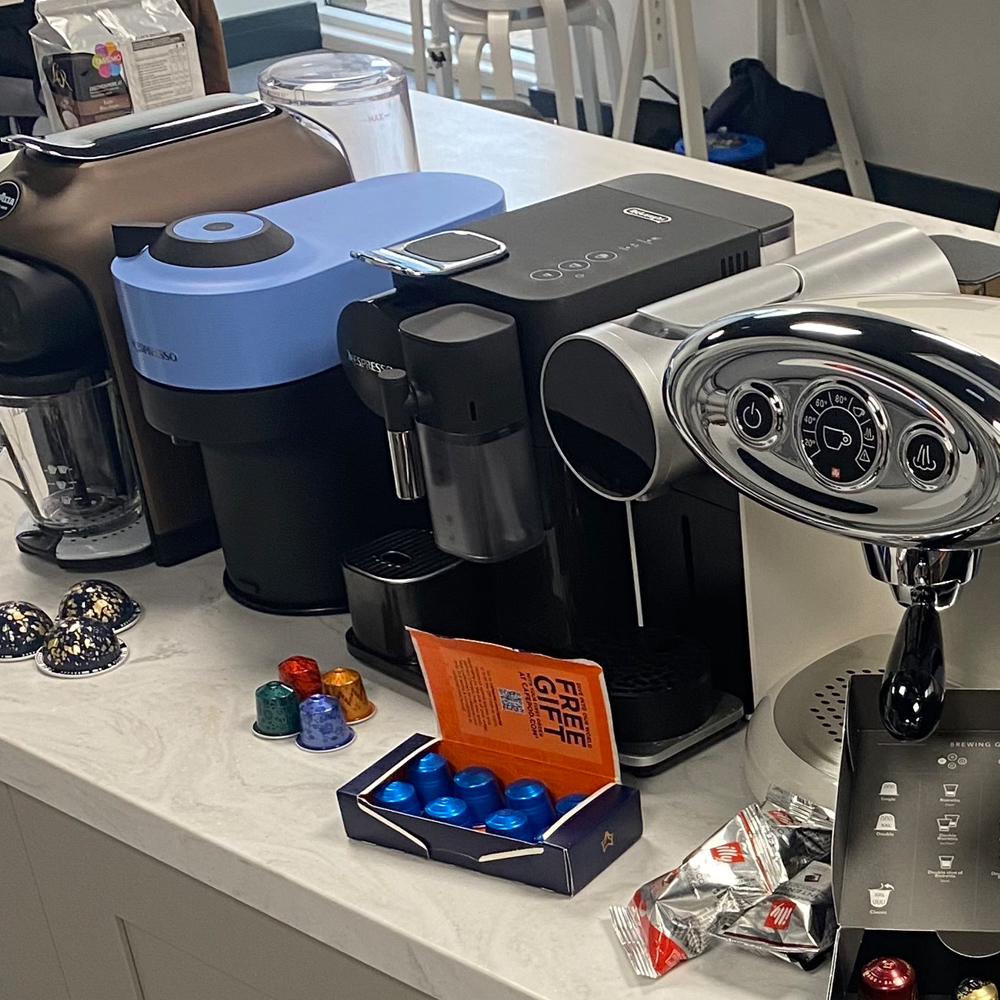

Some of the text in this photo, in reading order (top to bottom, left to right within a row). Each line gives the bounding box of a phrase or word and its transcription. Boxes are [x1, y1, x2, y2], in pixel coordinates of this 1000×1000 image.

[533, 675, 566, 742] GIFT
[555, 678, 587, 748] FREE
[714, 844, 739, 863] illy
[770, 903, 793, 926] illy
